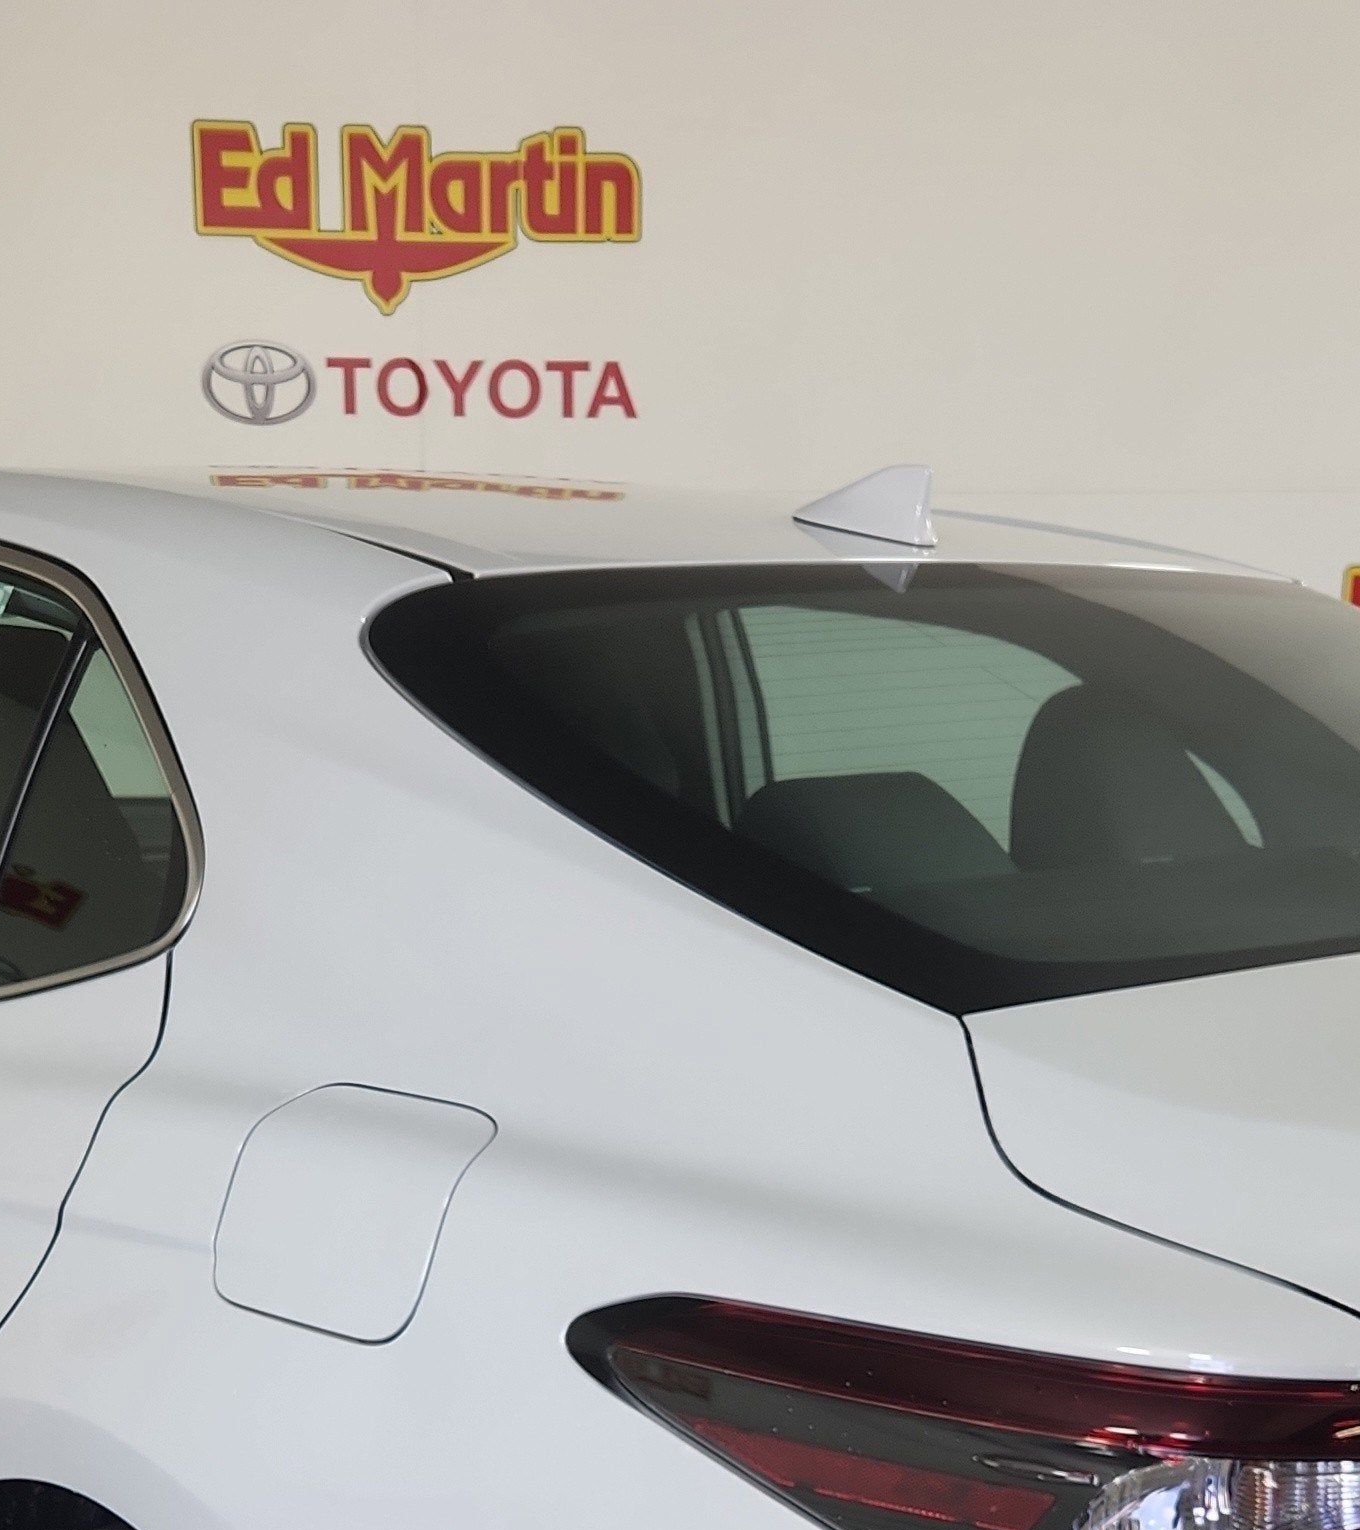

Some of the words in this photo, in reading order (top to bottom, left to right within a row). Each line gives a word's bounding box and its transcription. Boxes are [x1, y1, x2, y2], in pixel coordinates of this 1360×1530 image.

[192, 120, 320, 235] Ed
[341, 124, 643, 243] Martin
[326, 356, 637, 419] TOYOTA
